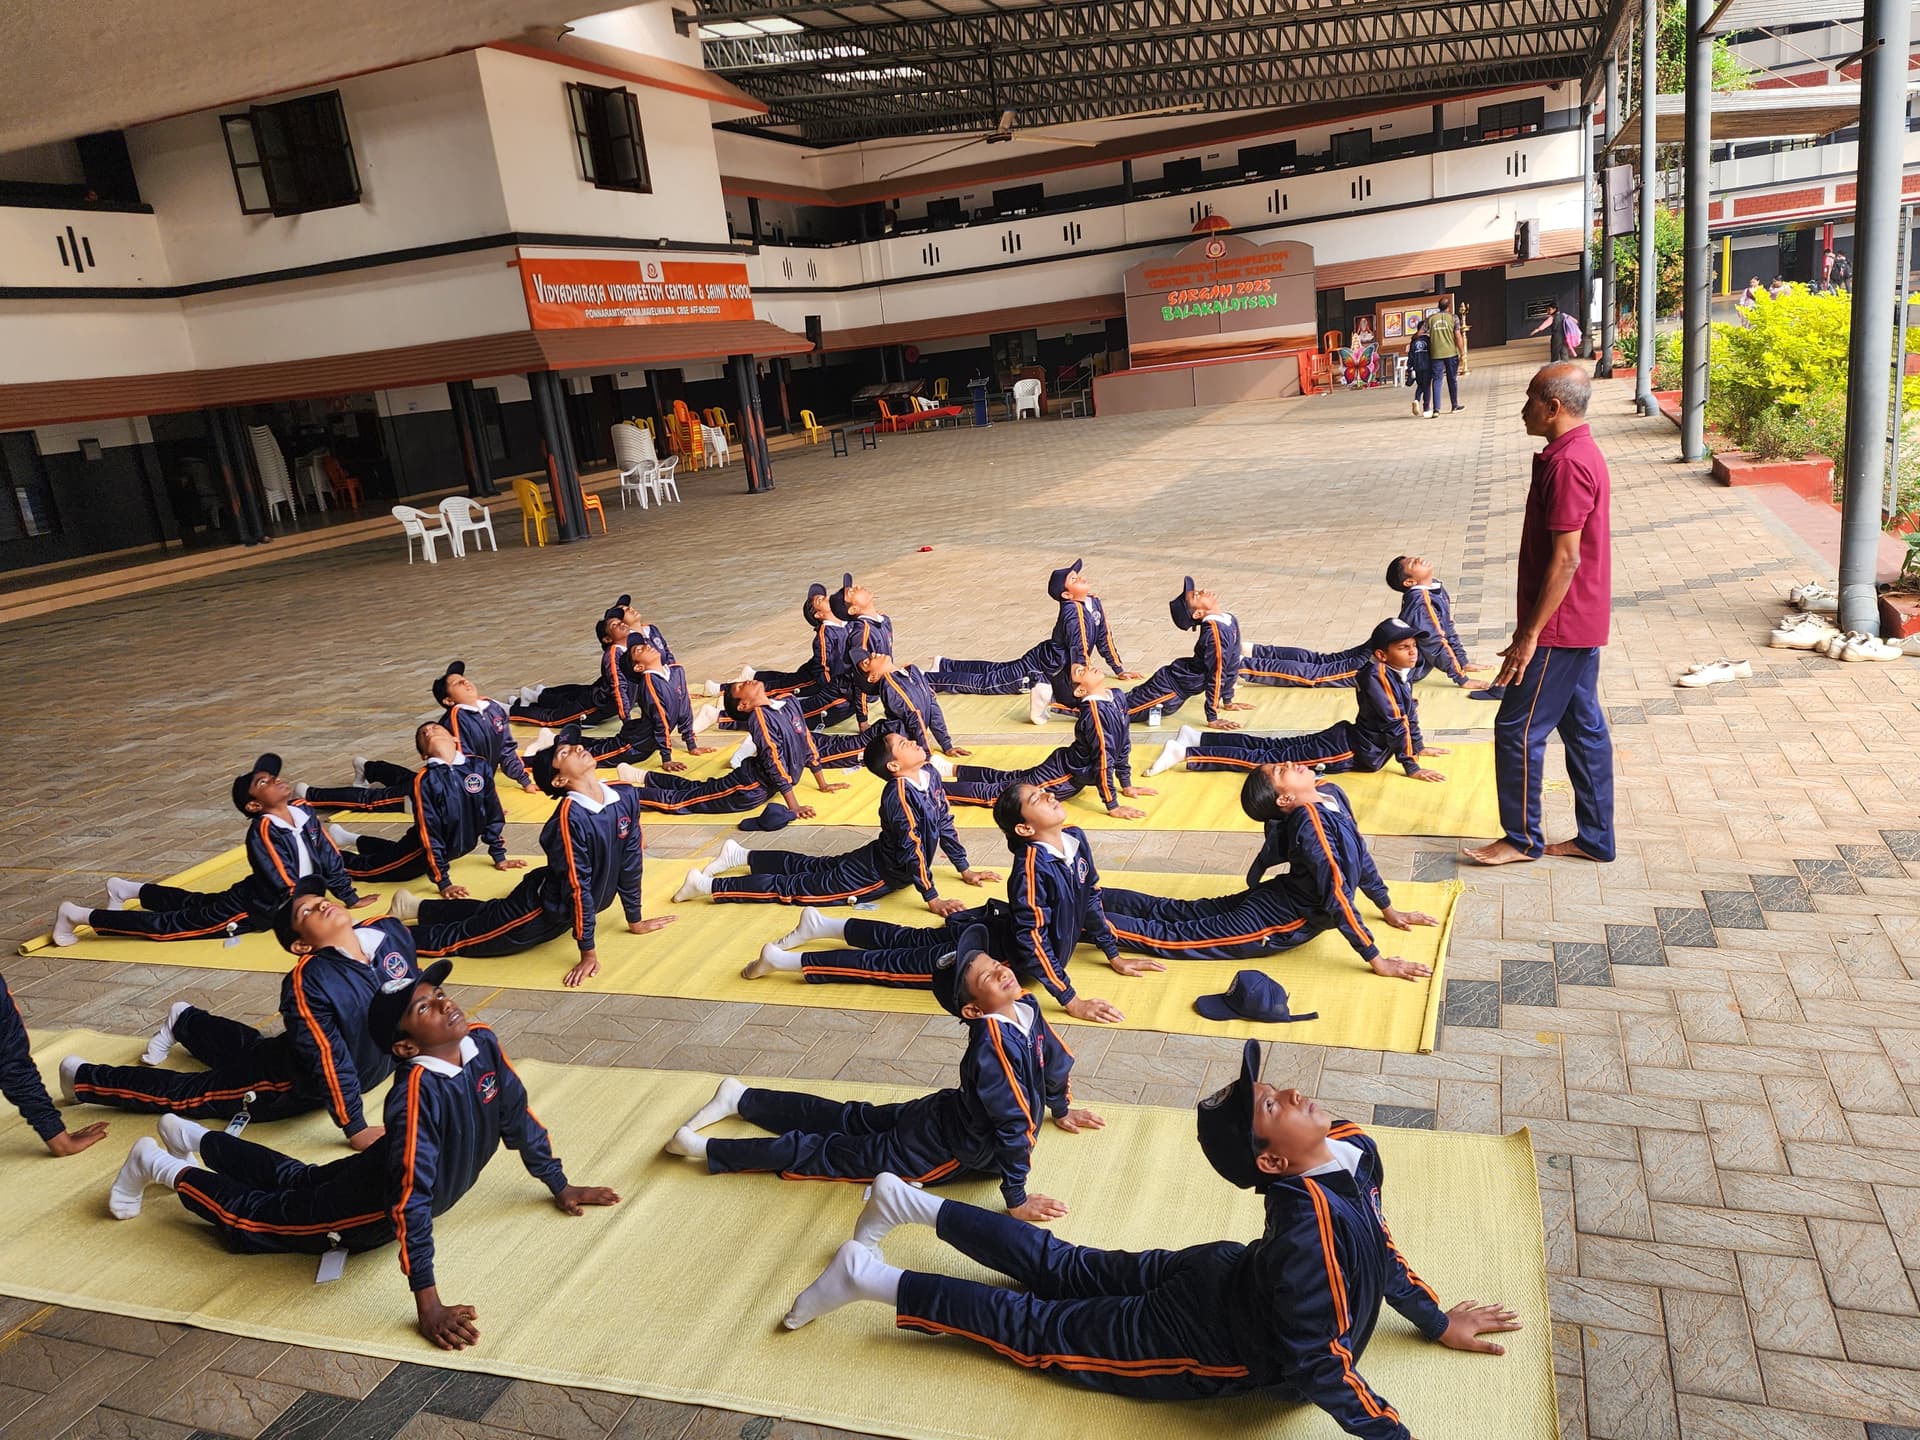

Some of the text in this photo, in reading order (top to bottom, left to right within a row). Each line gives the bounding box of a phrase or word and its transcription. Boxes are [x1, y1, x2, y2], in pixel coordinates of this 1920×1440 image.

[532, 273, 606, 305] VIDYADHIRAJA
[607, 283, 664, 304] VIDYAPEETOM
[665, 283, 697, 301] CENTRAL
[697, 283, 705, 300] &
[729, 283, 751, 300] SCHOOL
[1167, 278, 1271, 305] SARGAM 2025
[1162, 293, 1277, 321] BALAKALOTSAV
